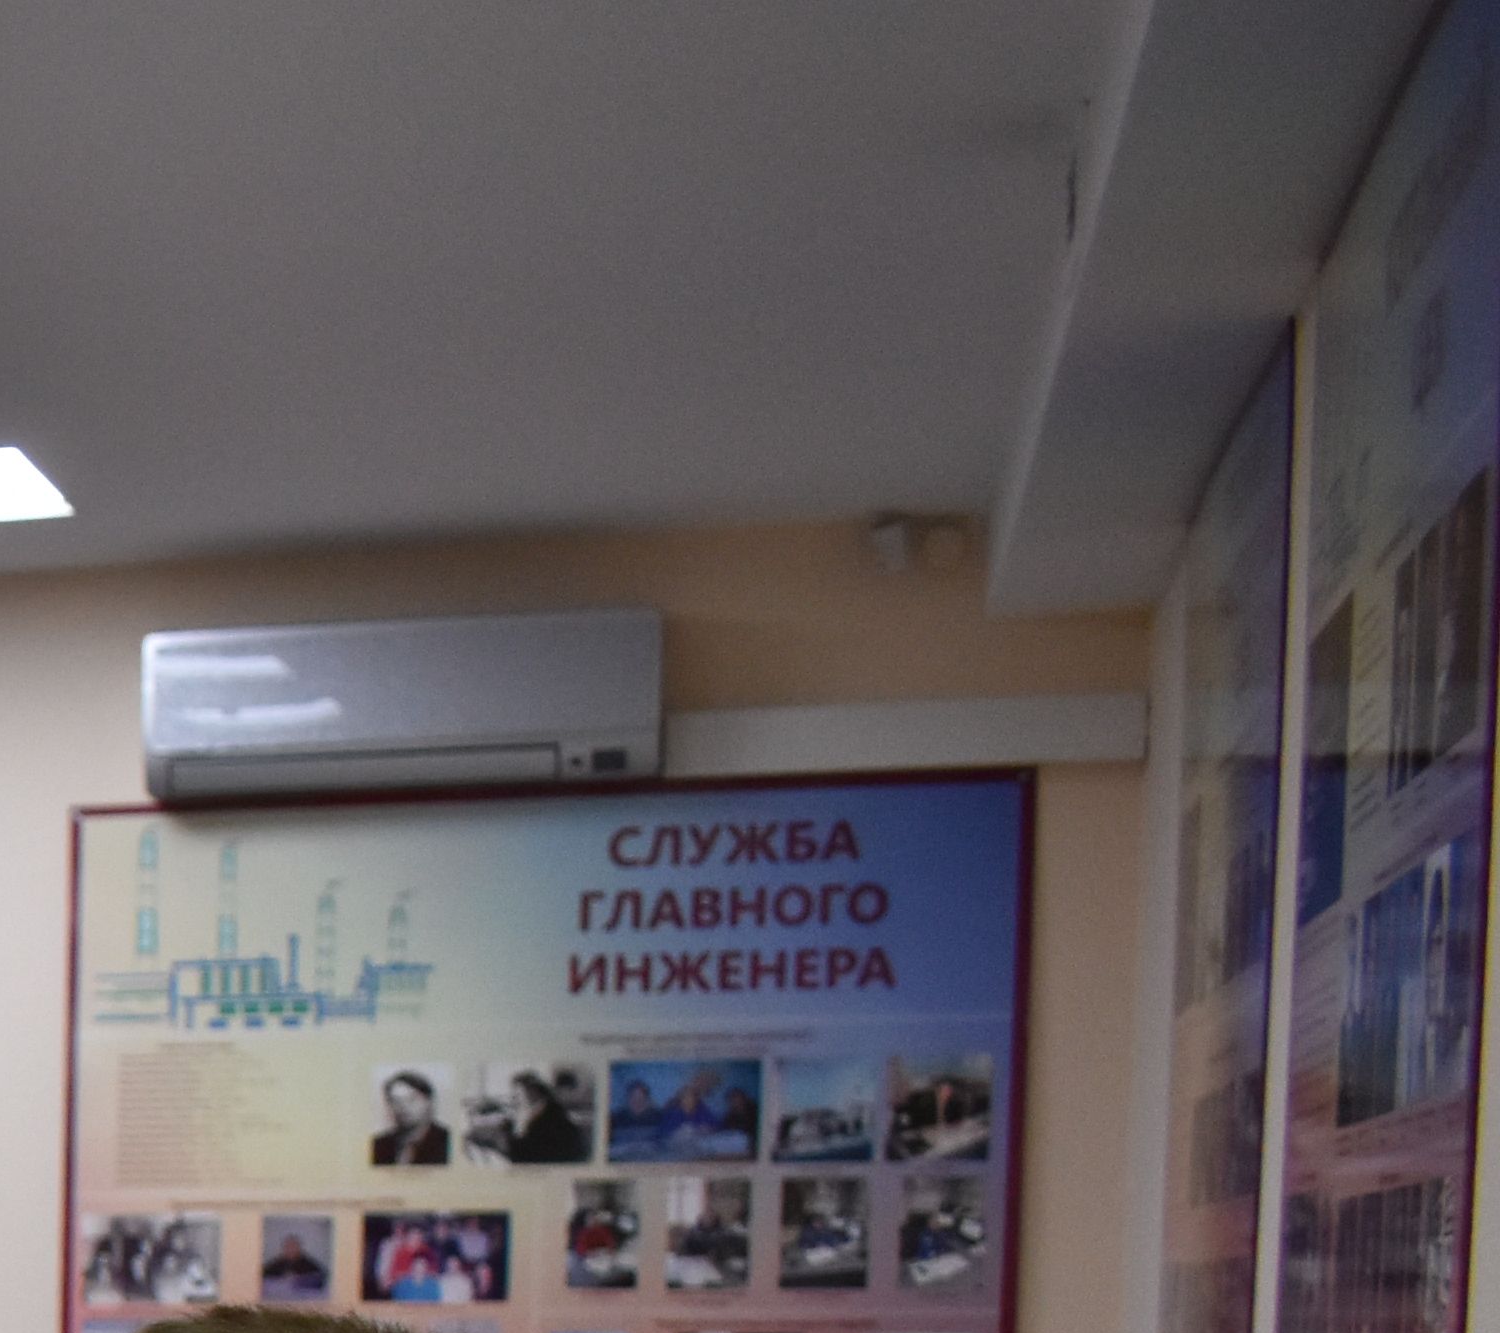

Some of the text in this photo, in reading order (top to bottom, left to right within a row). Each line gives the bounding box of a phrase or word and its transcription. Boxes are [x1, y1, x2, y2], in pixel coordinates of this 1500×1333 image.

[608, 819, 861, 869] СЛУЖБА
[577, 882, 890, 933] ГЛАВНОГО
[566, 947, 898, 995] ИНЖЕНЕРА
